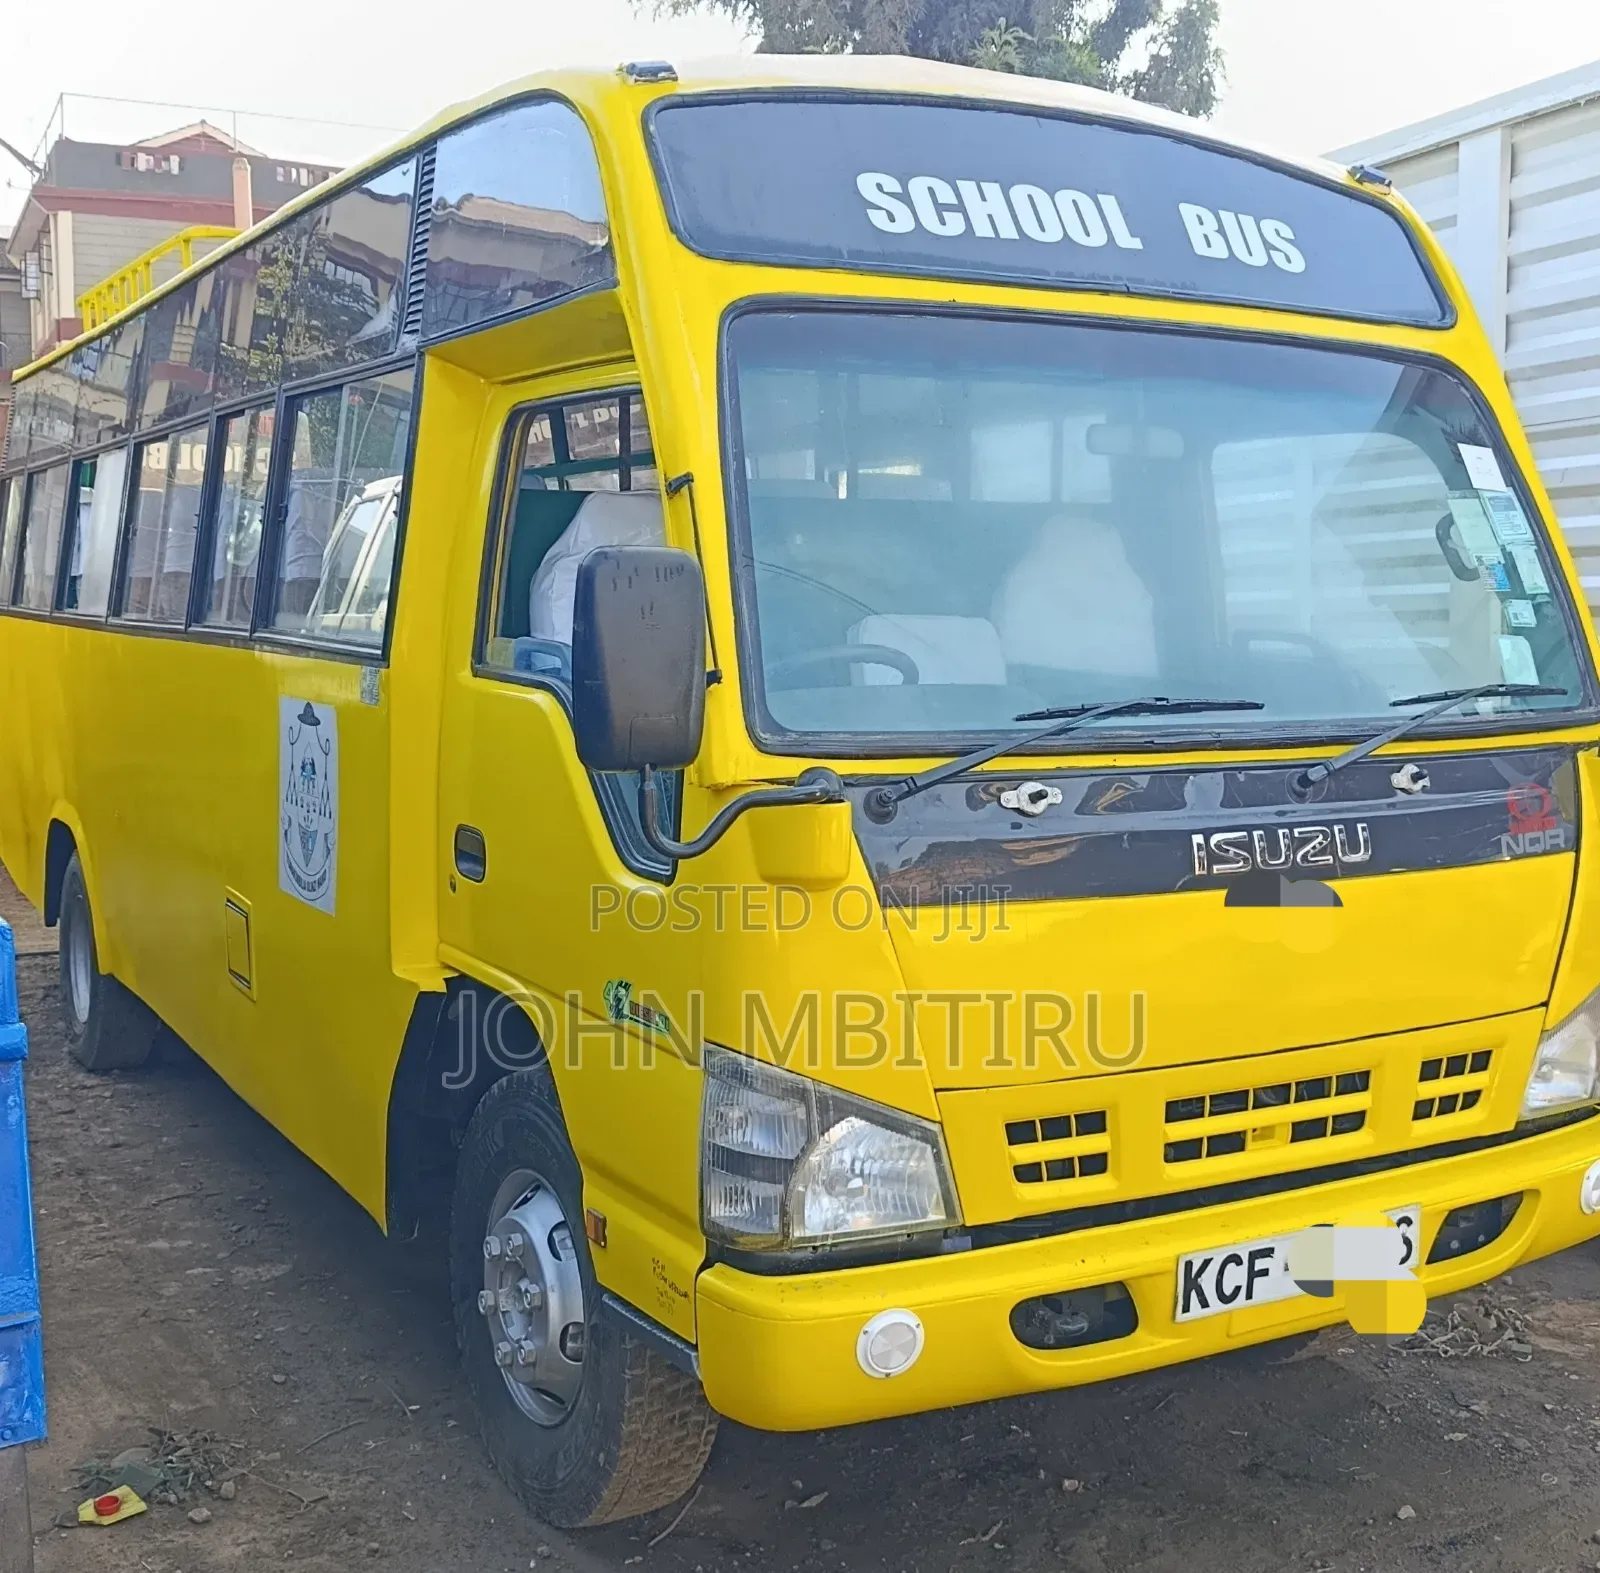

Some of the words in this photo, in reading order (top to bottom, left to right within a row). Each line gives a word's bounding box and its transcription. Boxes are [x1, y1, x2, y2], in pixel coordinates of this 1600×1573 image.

[856, 171, 1143, 250] SCHOOL
[1178, 202, 1306, 274] BUS
[1191, 823, 1372, 876] ISUZU
[1501, 828, 1565, 857] NQR
[1181, 1246, 1275, 1314] KCF
